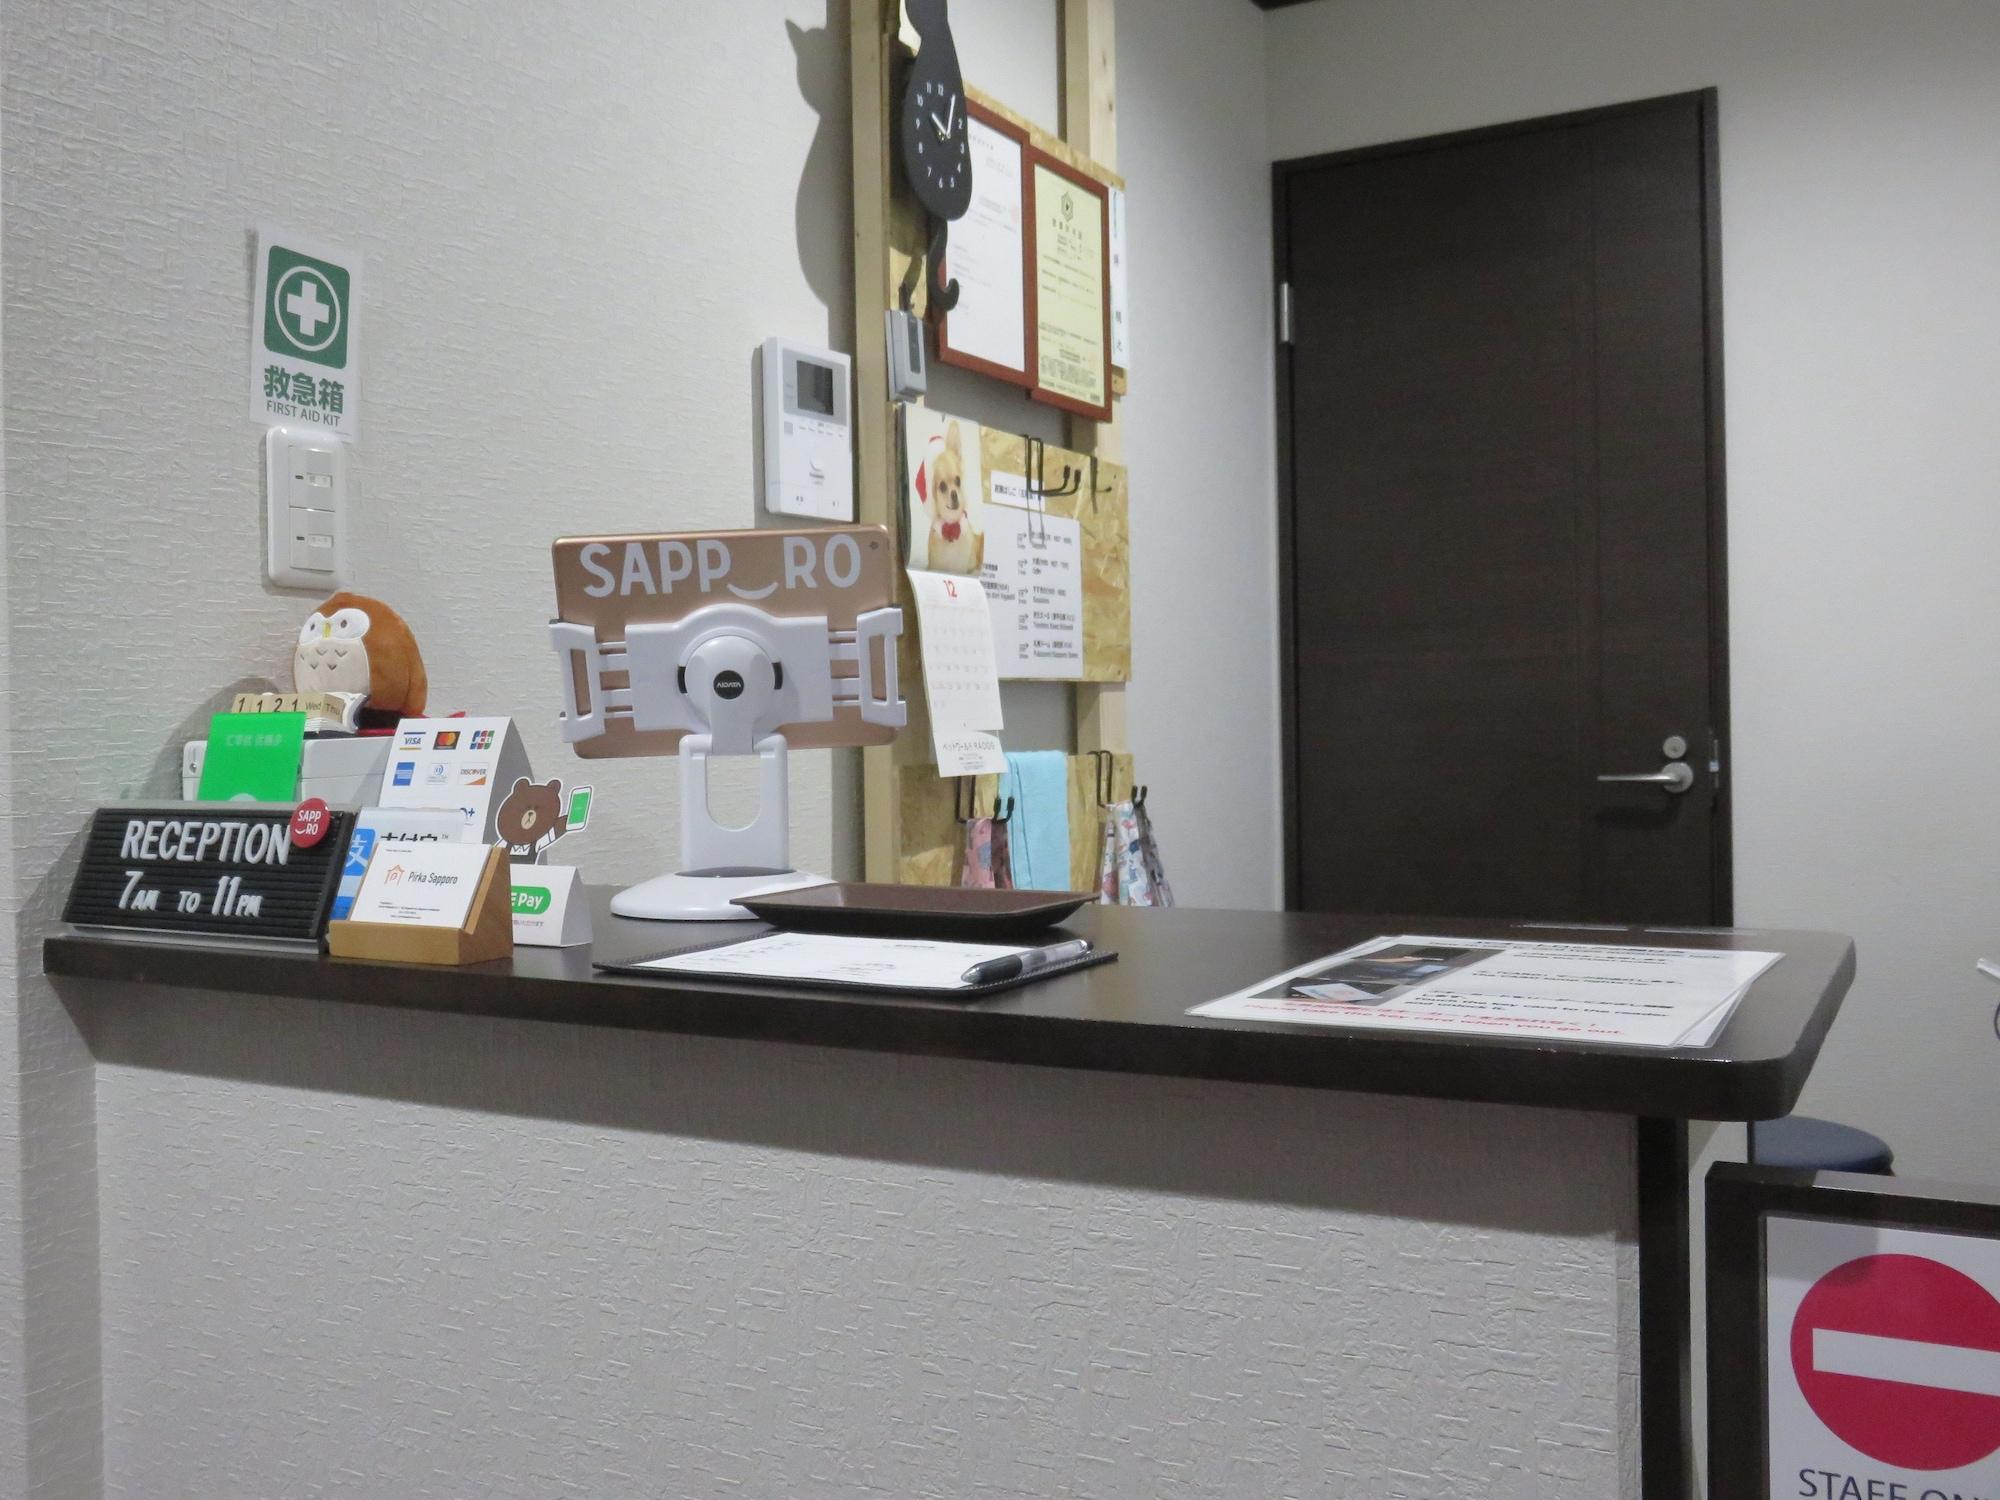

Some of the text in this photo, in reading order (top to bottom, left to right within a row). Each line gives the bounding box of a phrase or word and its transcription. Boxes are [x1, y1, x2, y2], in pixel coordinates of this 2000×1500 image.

[263, 365, 344, 414] 救急箱
[266, 400, 341, 427] FIRST AID KIT
[943, 579, 958, 598] 12
[306, 702, 321, 711] Wed
[326, 703, 341, 715] Thu
[404, 737, 422, 745] VISA
[460, 768, 487, 776] DISCOVER
[120, 820, 291, 865] RECEPTION
[408, 871, 458, 886] Pirka Sapporo
[177, 891, 201, 914] TO
[518, 894, 544, 910] Pay
